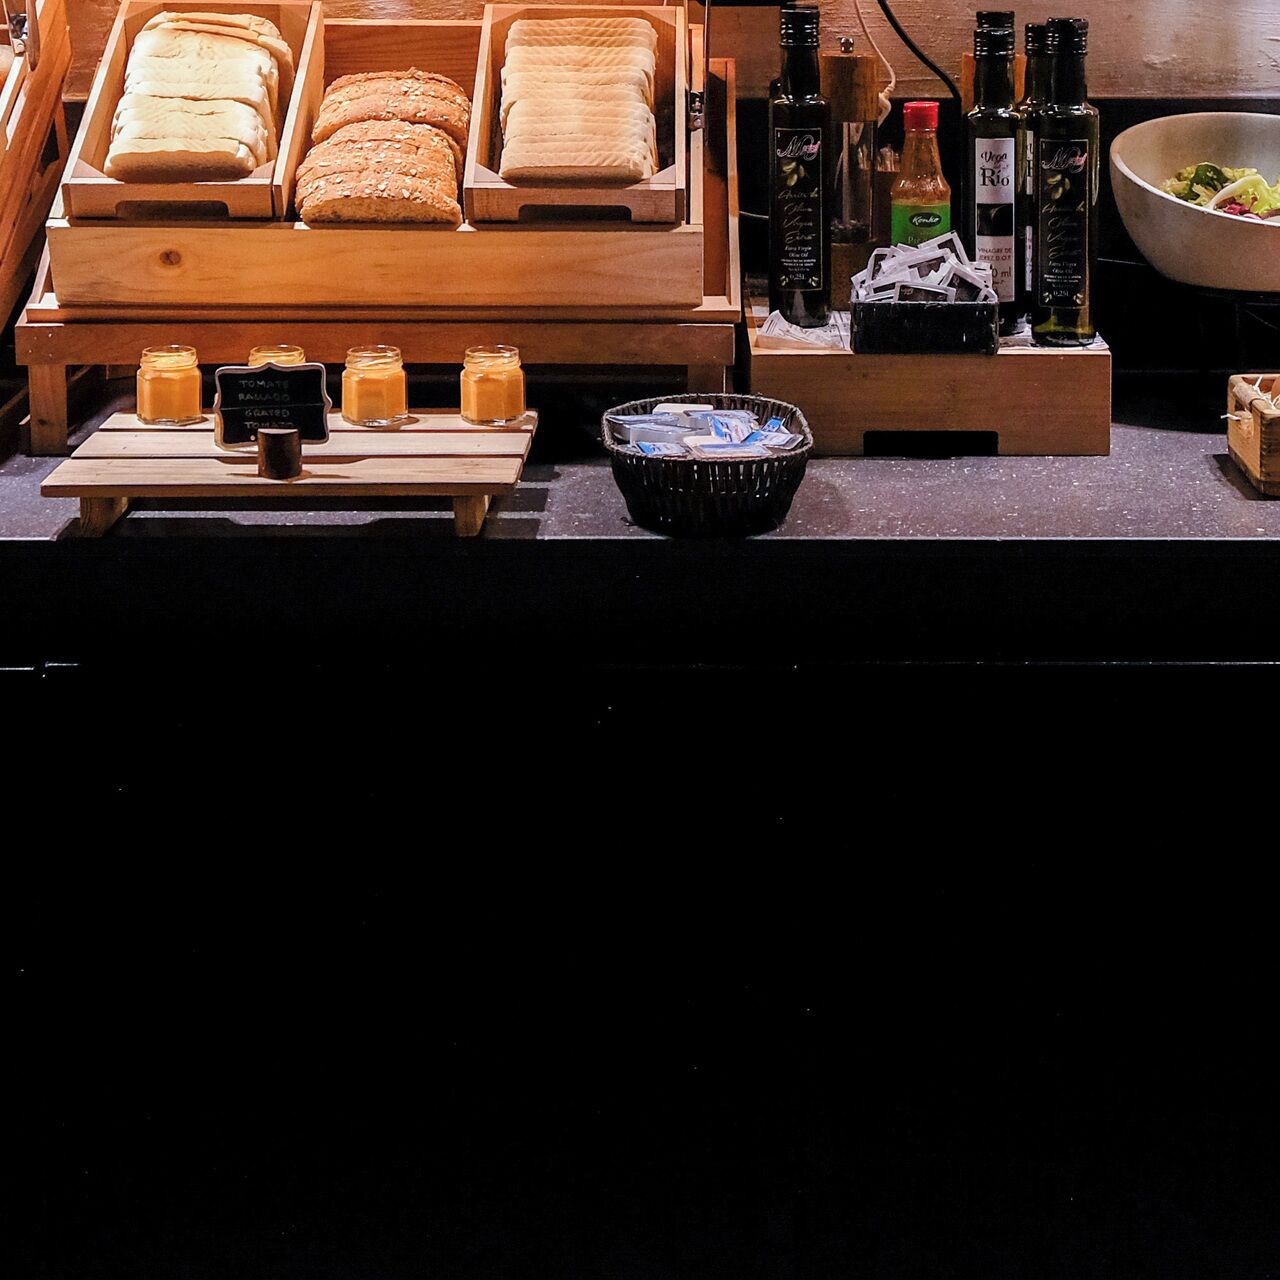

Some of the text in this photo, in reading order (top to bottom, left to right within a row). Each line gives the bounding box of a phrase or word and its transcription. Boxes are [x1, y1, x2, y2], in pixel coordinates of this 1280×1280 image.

[981, 151, 1008, 163] Vega
[980, 166, 1010, 187] Río
[1001, 267, 1011, 278] ml
[239, 380, 289, 389] TOMATE
[245, 409, 290, 417] GRATED
